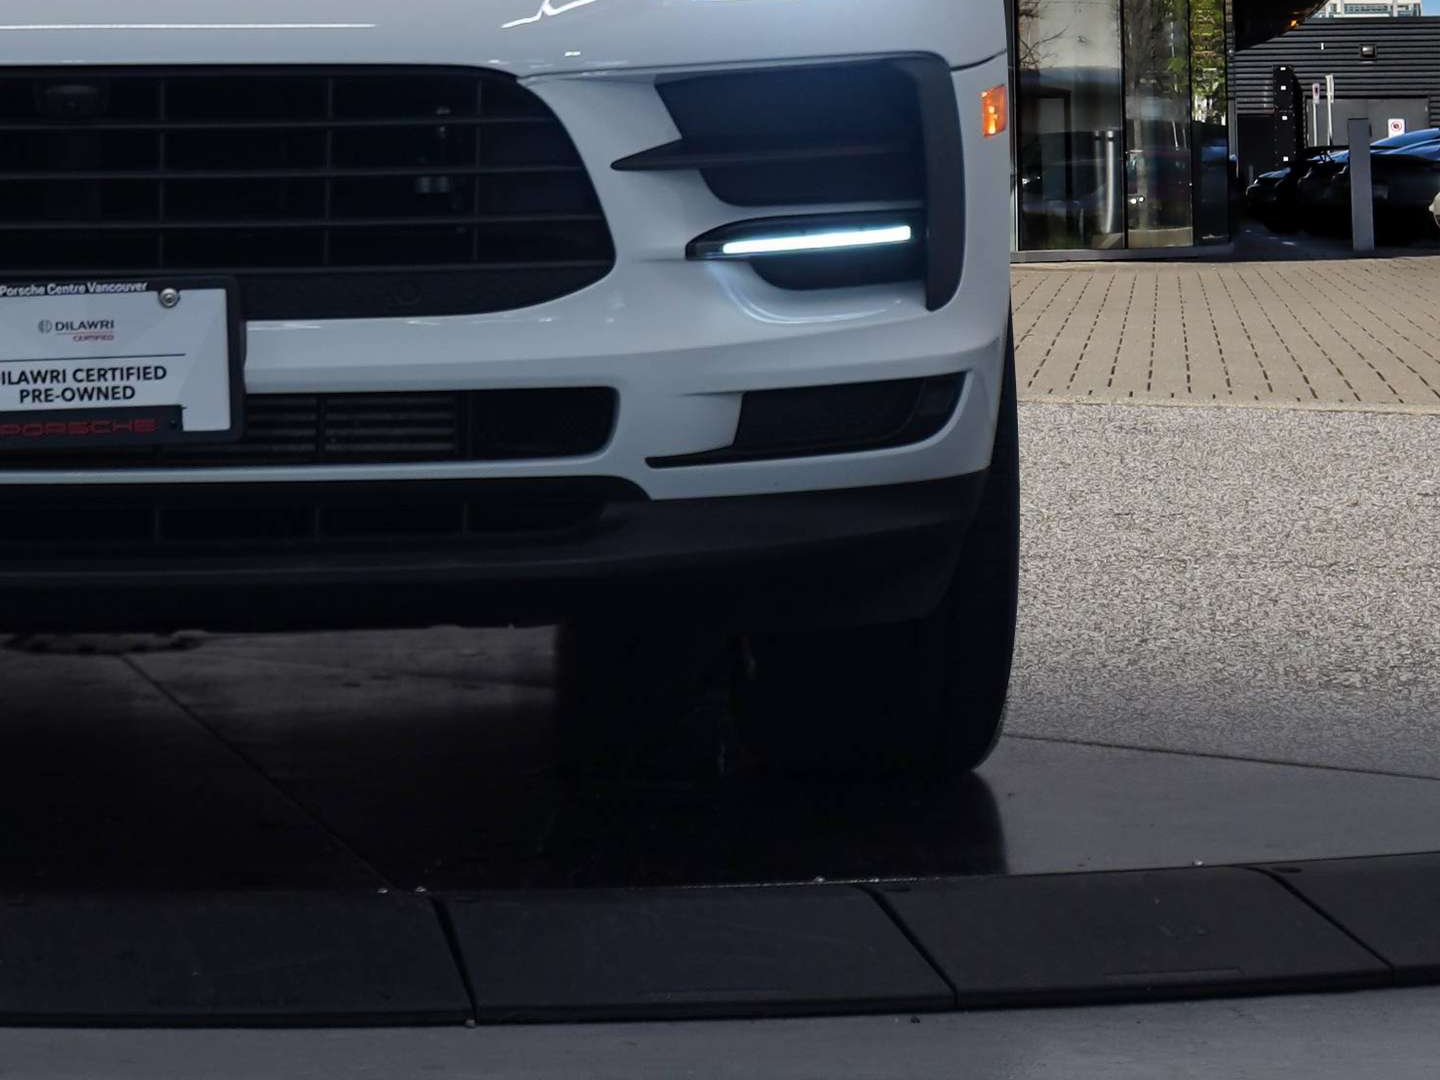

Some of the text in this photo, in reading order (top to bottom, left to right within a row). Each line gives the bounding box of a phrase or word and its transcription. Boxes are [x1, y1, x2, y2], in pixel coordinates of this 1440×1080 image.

[46, 283, 86, 295] Centre
[86, 281, 148, 294] Vancouver
[55, 320, 115, 332] DILAWRI
[72, 365, 168, 384] CERTIFIED
[19, 385, 136, 404] PRE-OWNED
[0, 419, 156, 436] PORSCHE
